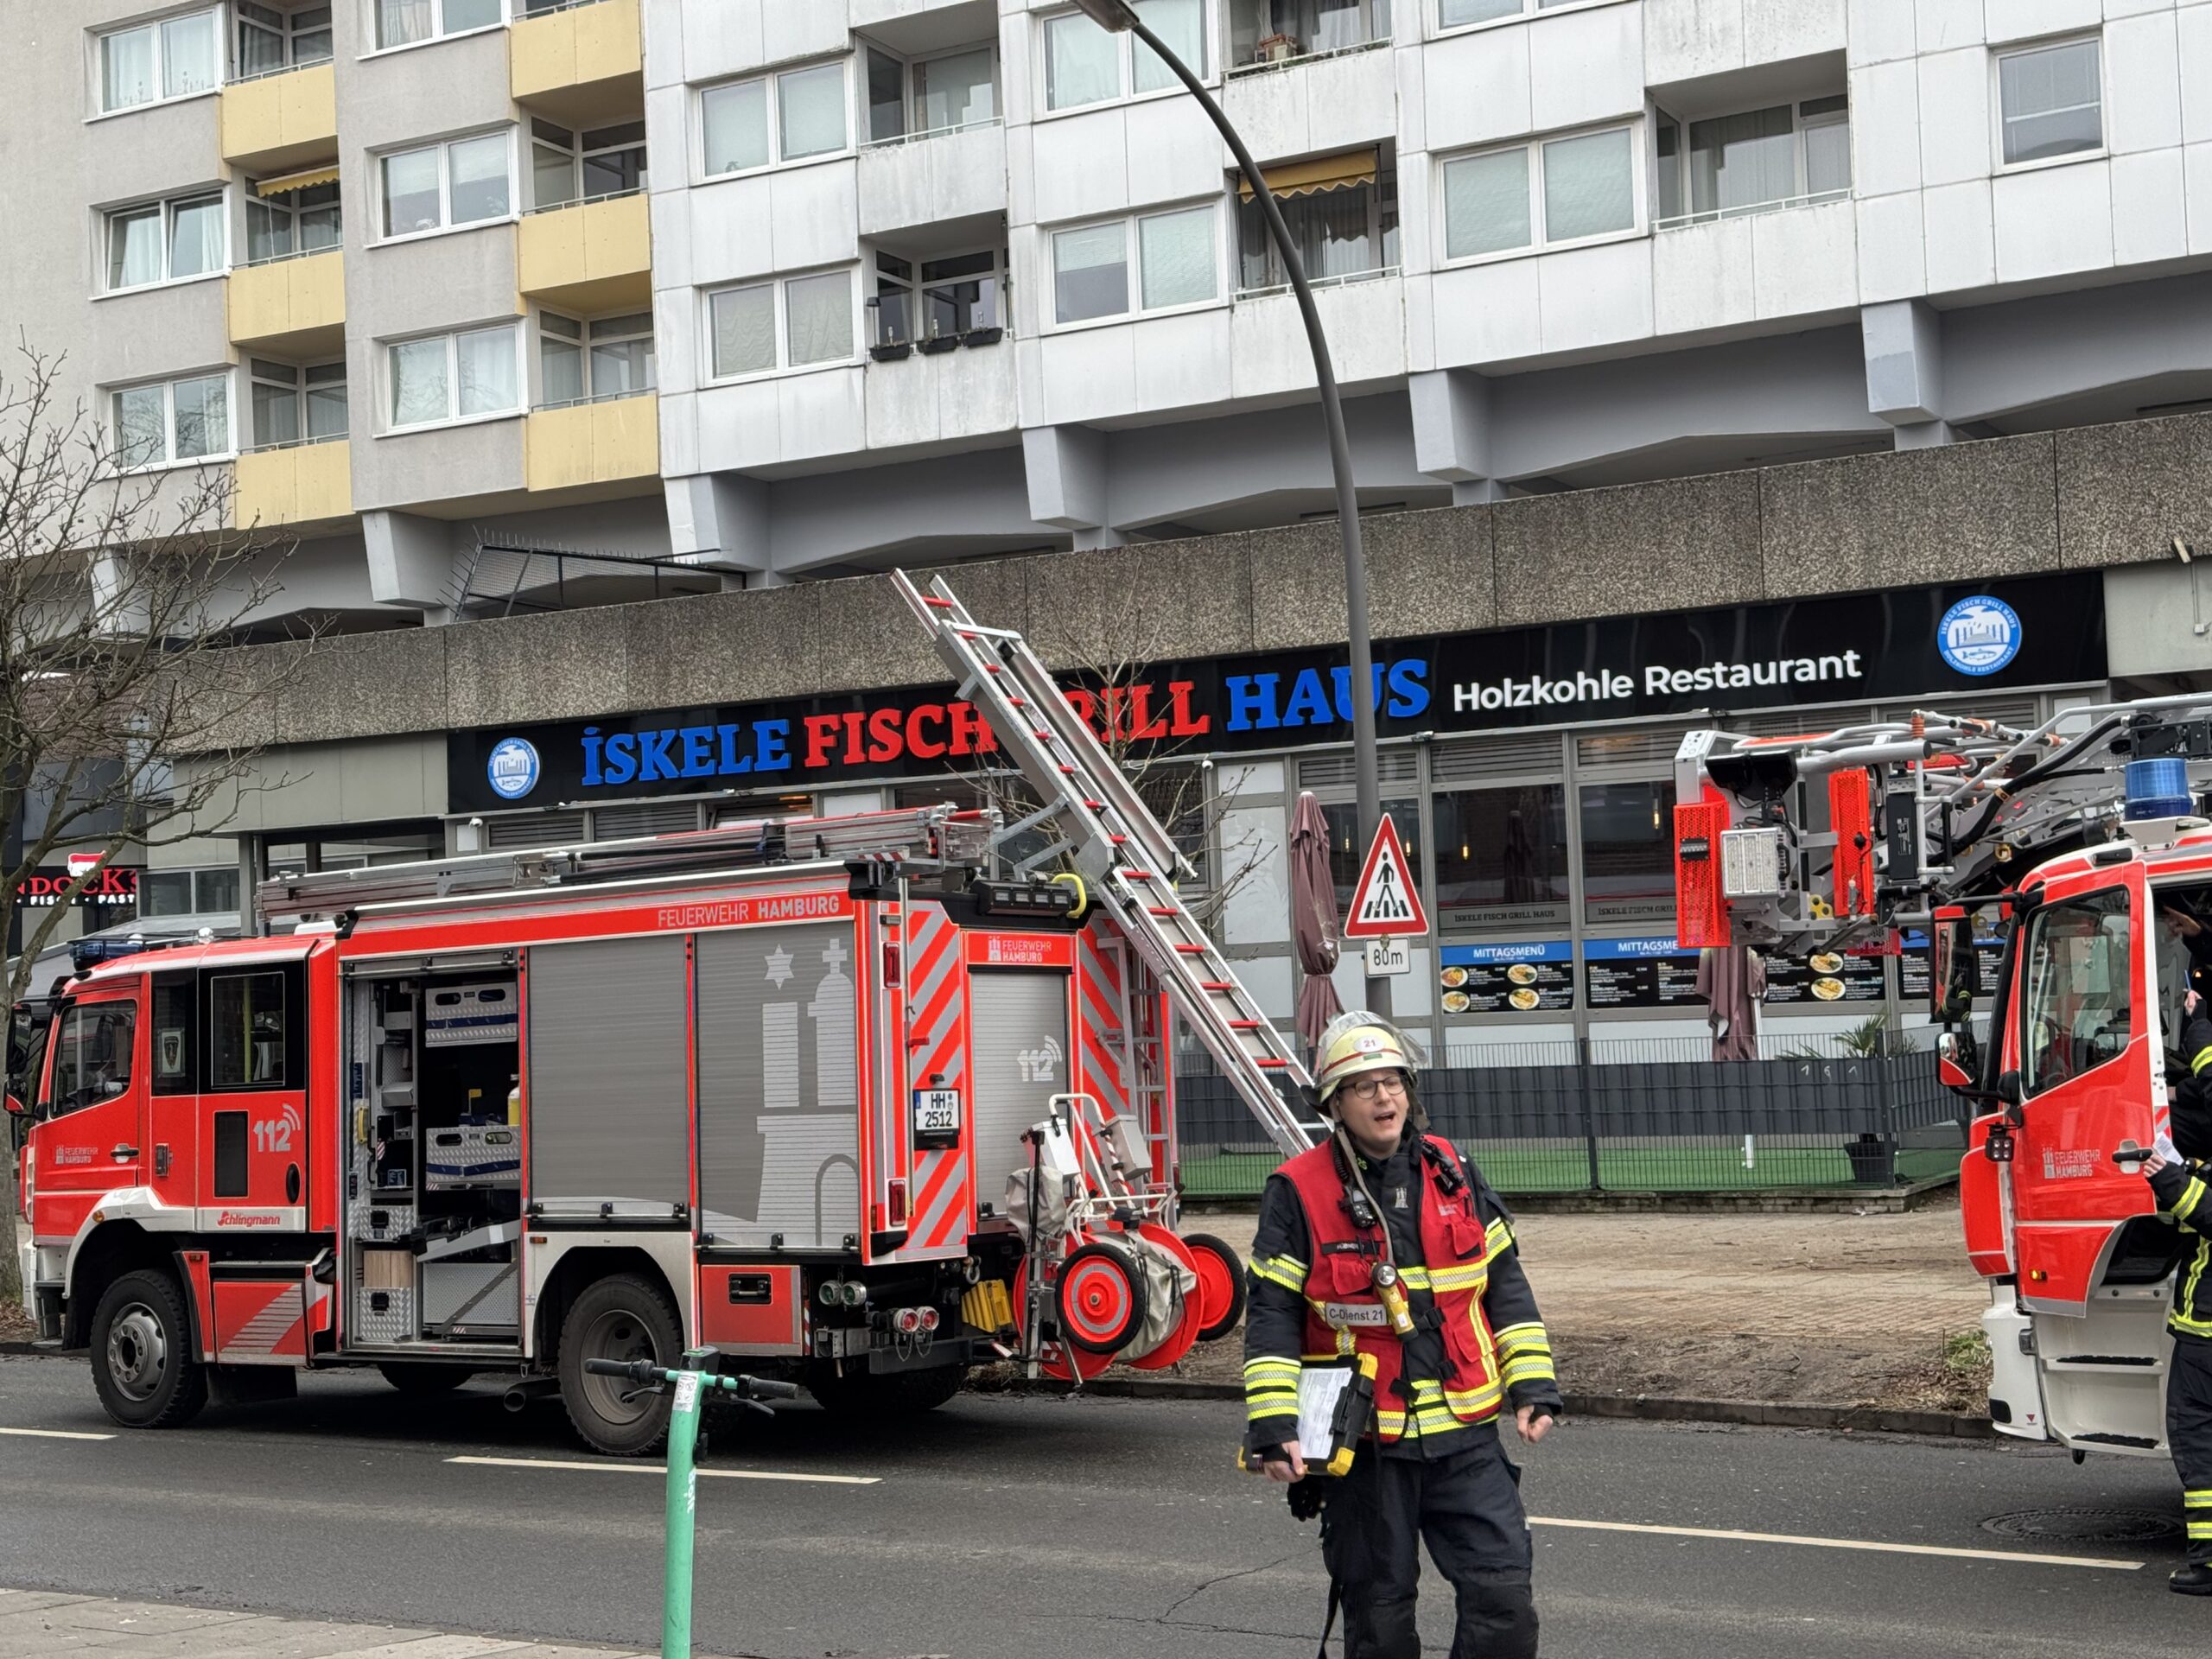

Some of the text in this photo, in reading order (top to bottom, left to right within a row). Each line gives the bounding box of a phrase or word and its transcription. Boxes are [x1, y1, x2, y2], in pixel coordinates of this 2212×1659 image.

[1453, 649, 1862, 712] Holzkohle Restaurant
[581, 718, 792, 786] İSKELE
[804, 701, 998, 768] FISCH
[1062, 681, 1211, 743] RILL
[30, 895, 76, 906] FIS
[658, 895, 840, 928] FEUERWEHR HAMBURG
[1484, 912, 1507, 921] FISCH
[1509, 912, 1532, 920] GRILL
[1533, 910, 1555, 919] HAUS
[1002, 940, 1052, 951] FEUERWEHR
[1473, 944, 1545, 958] MITTAGSMENÜ
[1618, 940, 1679, 952] MITTAGSME
[1002, 951, 1043, 963] HAMBURG
[1363, 1039, 1376, 1048] 21
[1017, 1049, 1053, 1081] 112
[931, 1092, 945, 1109] HH
[925, 1110, 953, 1128] 2512
[253, 1119, 291, 1152] 112
[2055, 1148, 2101, 1165] FEUERWEHR
[2056, 1163, 2094, 1179] HAMBURG
[218, 1211, 280, 1227] Schlingmann
[1329, 1307, 1383, 1323] C-Dienst 21
